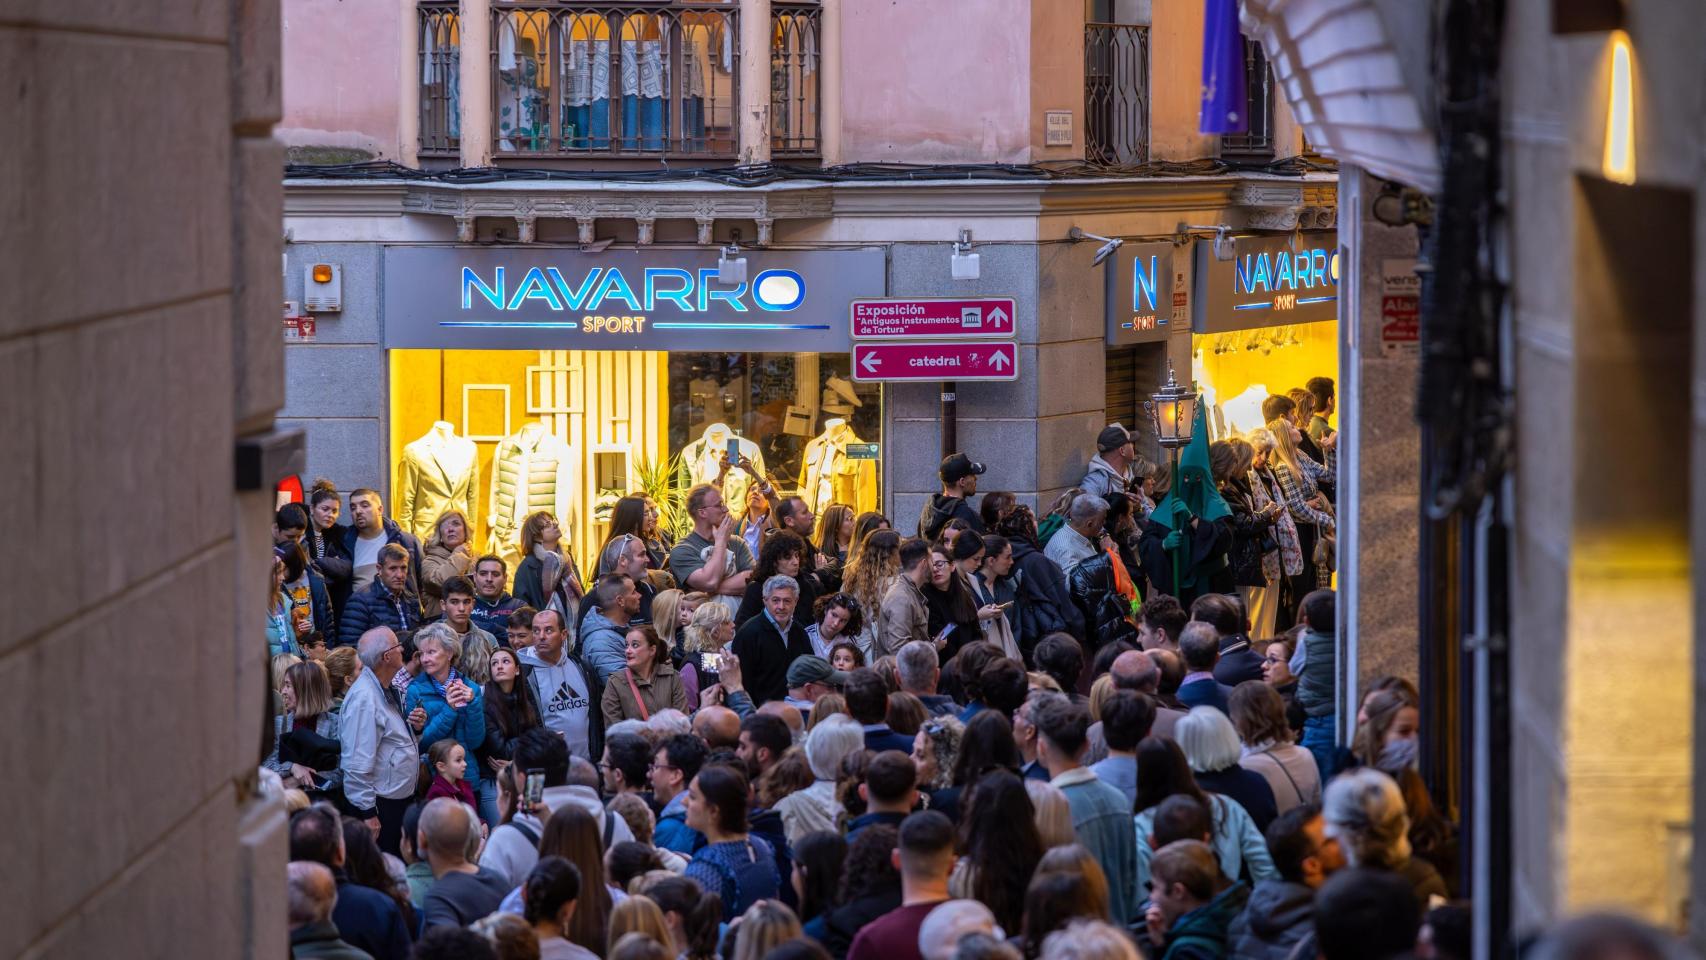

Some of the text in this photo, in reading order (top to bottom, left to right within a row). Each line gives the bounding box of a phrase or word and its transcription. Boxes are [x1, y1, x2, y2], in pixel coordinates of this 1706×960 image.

[461, 266, 806, 312] NAVARRO
[1134, 255, 1157, 312] N
[1274, 294, 1296, 310] SPORT
[857, 304, 925, 318] Exposición
[582, 316, 646, 333] SPORT
[901, 316, 960, 325] Instrumentos
[1133, 314, 1156, 332] SPORT
[860, 326, 872, 334] de
[909, 355, 961, 367] catedral
[548, 698, 587, 713] adidas
